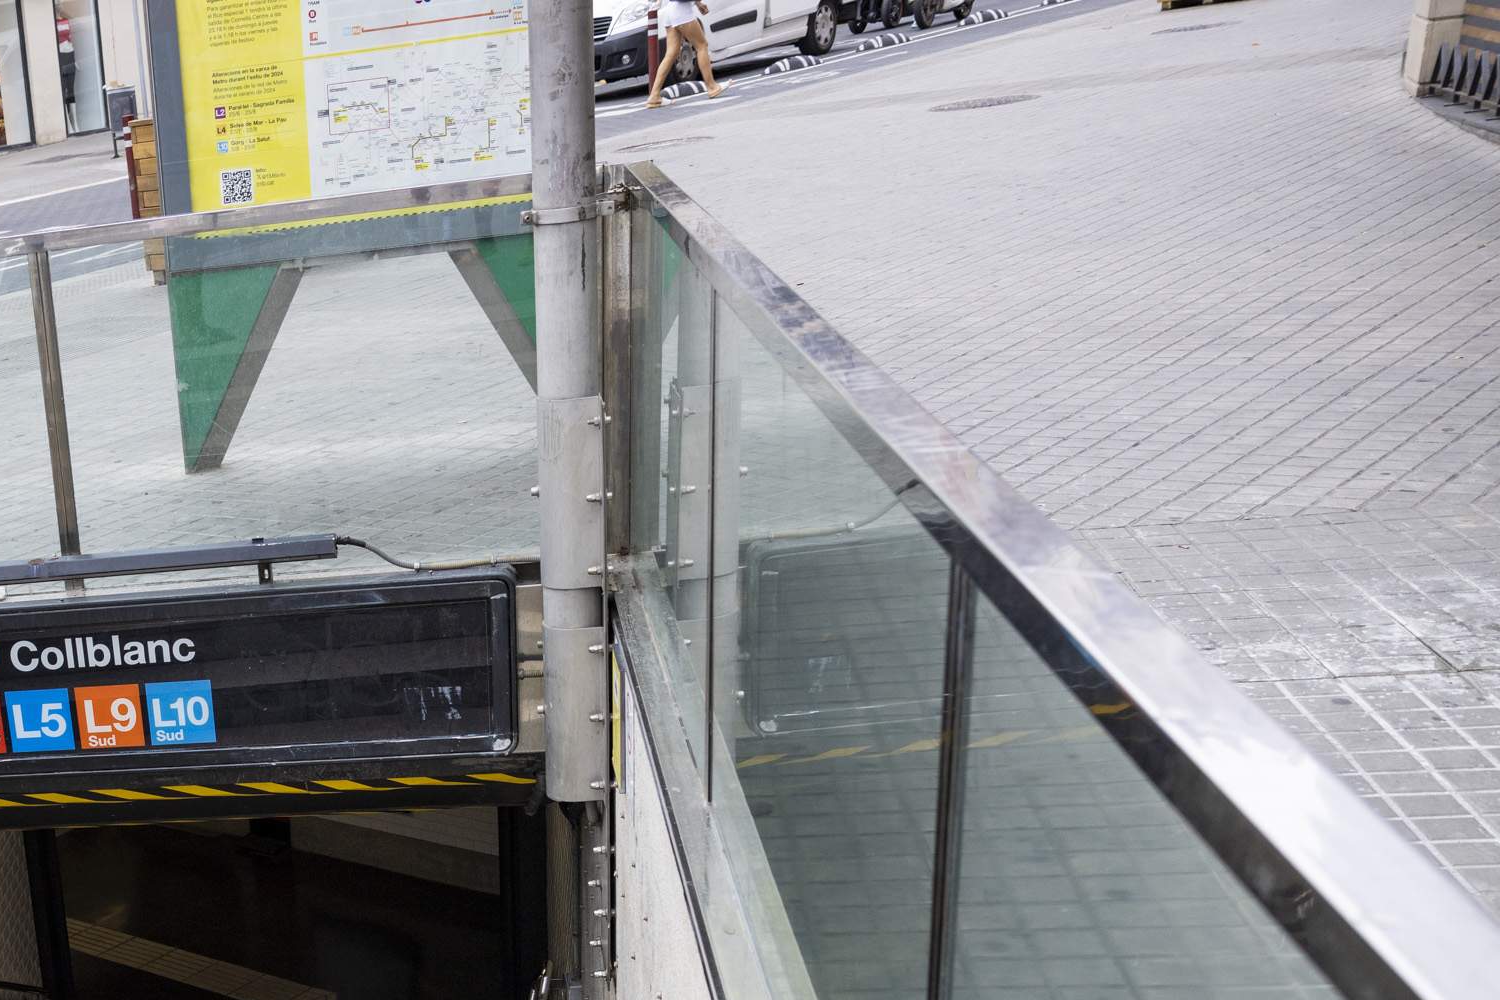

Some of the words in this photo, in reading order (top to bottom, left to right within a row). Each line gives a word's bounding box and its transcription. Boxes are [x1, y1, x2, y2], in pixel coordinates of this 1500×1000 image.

[10, 634, 196, 672] Collblanc
[12, 702, 67, 739] L5
[83, 697, 137, 734] L9
[152, 695, 210, 728] L10
[88, 734, 116, 747] Sud
[156, 729, 185, 742] Sud
